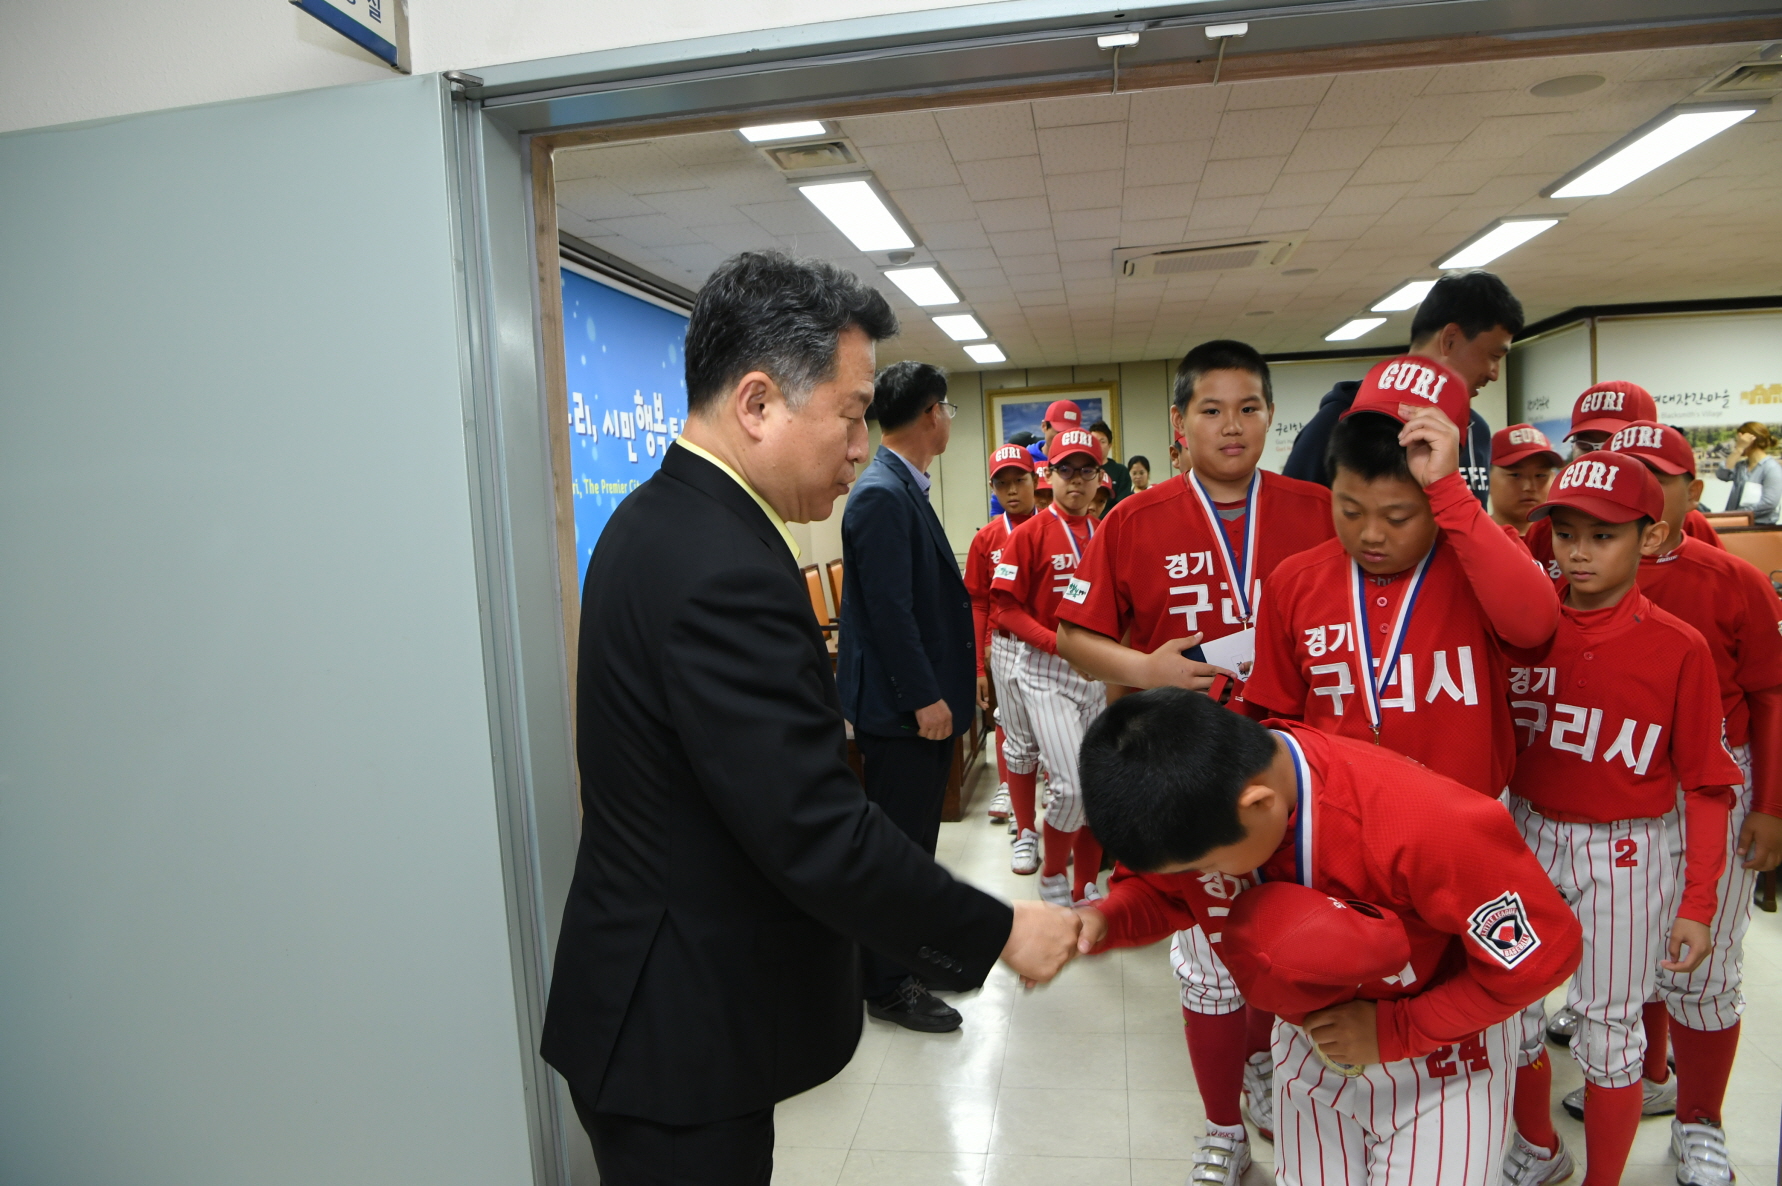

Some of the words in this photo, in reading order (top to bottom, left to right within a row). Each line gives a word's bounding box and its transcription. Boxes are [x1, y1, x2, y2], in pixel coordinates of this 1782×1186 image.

[1377, 362, 1448, 404] GURI
[1580, 391, 1625, 412] GURI
[568, 391, 597, 443] 리,
[1061, 430, 1093, 448] GURI
[1610, 426, 1664, 451] GURI
[995, 446, 1021, 462] GURI
[584, 479, 599, 494] The
[601, 479, 627, 494] Premier
[1559, 460, 1620, 492] GURI
[1051, 553, 1079, 570] 경기
[1163, 550, 1214, 579] 경기
[1304, 622, 1355, 657] 경기
[1508, 667, 1557, 696] 경기
[1511, 700, 1662, 776] 구리시
[1615, 838, 1638, 868] 2
[1481, 917, 1497, 937] LITTLE
[1495, 908, 1517, 919] LEAGUE
[1503, 933, 1529, 957] BASEBALL
[1426, 1033, 1490, 1079] 24
